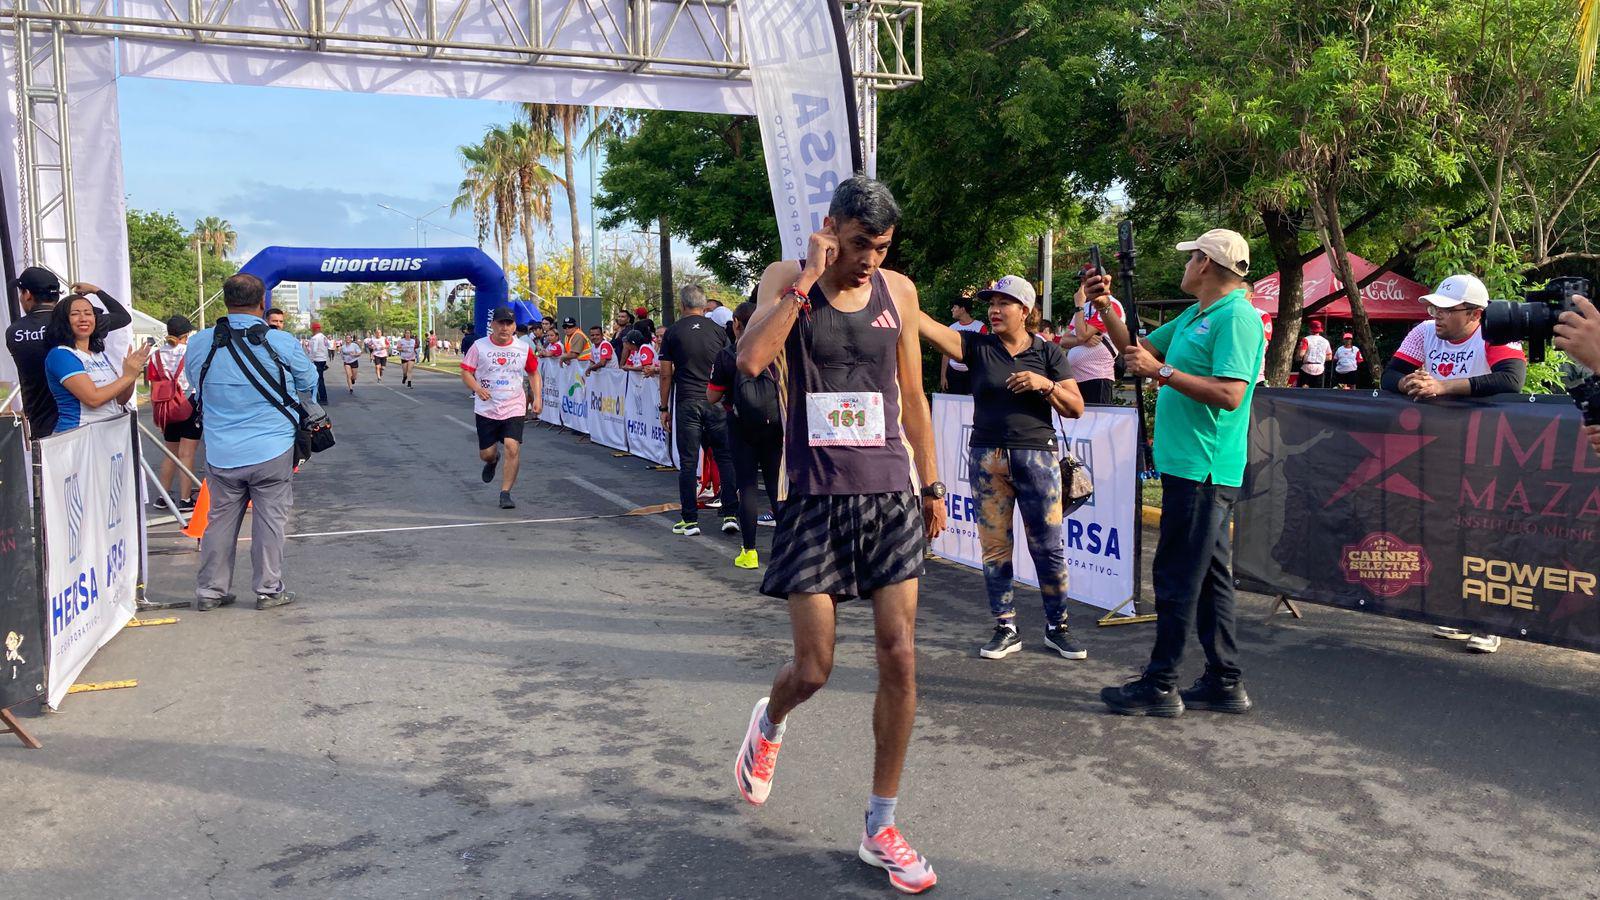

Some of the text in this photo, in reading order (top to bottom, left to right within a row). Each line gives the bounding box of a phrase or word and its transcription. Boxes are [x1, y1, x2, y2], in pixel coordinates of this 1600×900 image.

[486, 351, 521, 359] CARRERA
[1428, 349, 1474, 363] CARRERA
[828, 410, 866, 428] 151
[627, 420, 648, 438] HERSA
[1348, 550, 1420, 562] CARNES
[1349, 560, 1421, 572] SELECTAS
[1360, 571, 1412, 580] NAYARIT
[1462, 555, 1597, 596] POWER
[52, 566, 100, 637] HERSA
